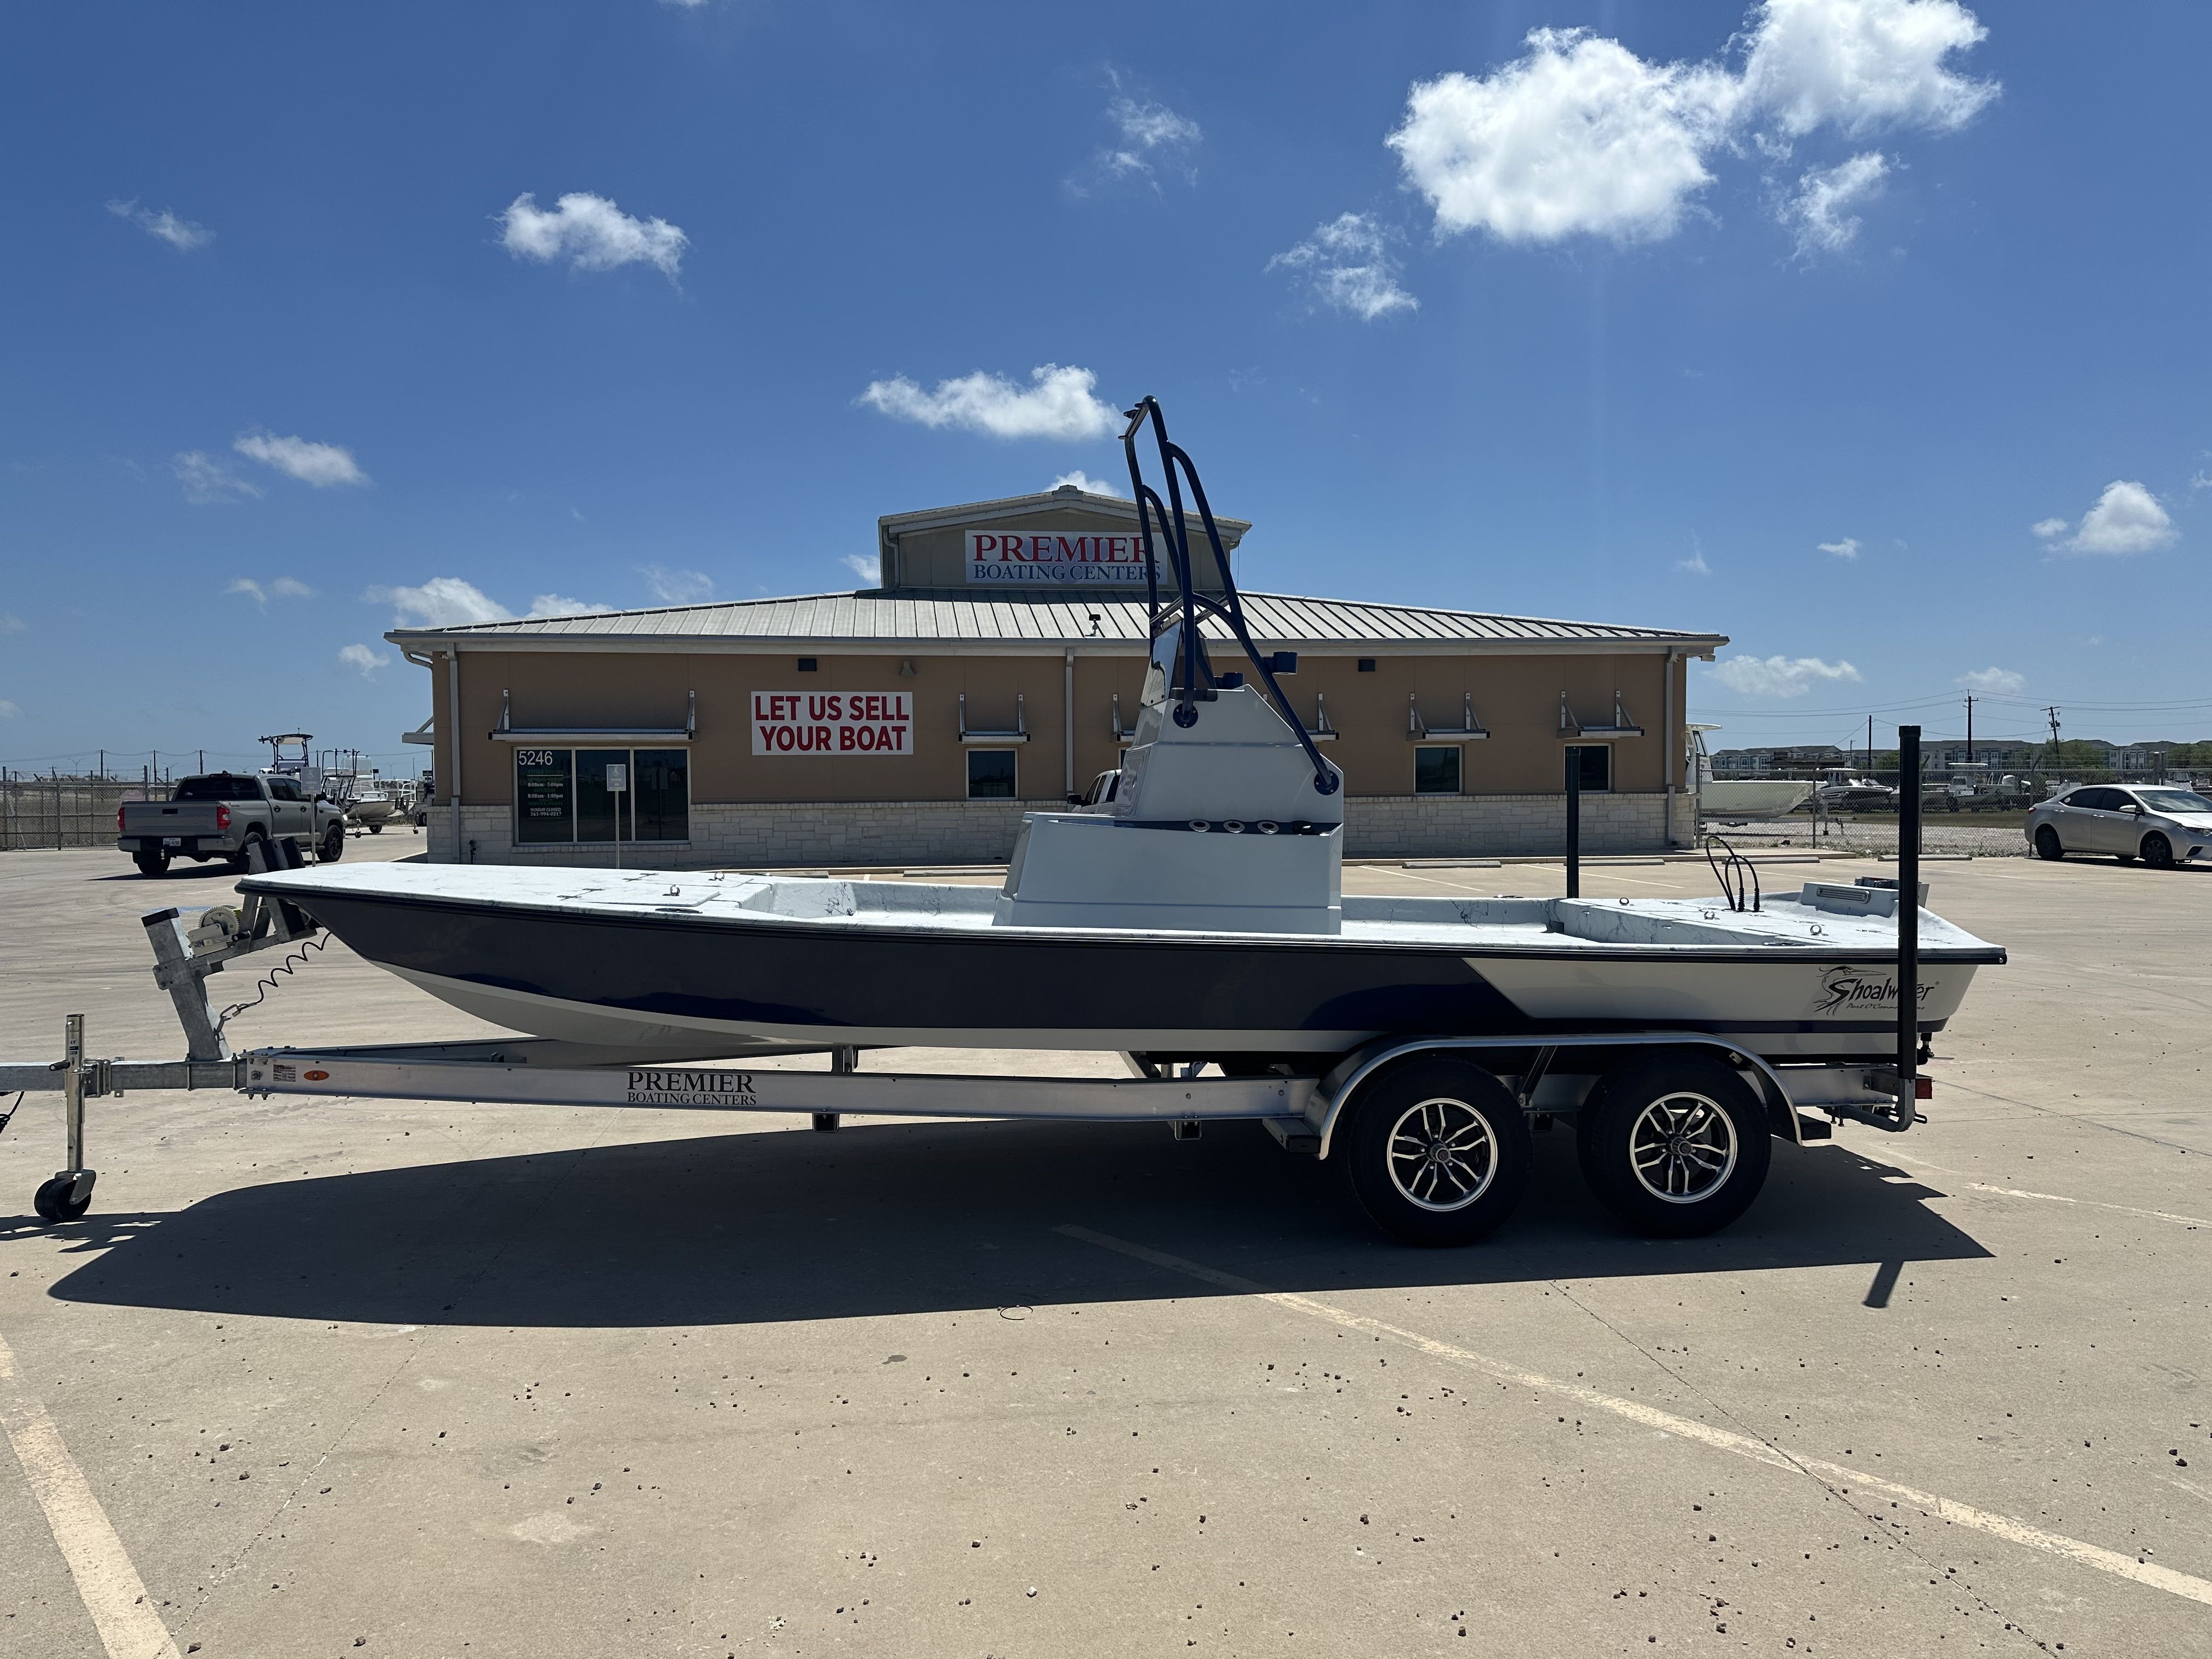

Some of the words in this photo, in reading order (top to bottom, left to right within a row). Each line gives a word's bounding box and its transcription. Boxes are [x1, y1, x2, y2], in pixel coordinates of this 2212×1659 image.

[973, 535, 1160, 563] PREMIER
[974, 564, 1065, 580] BOATING
[1070, 565, 1161, 580] CENTERS
[755, 696, 801, 721] LET
[809, 696, 842, 721] US
[849, 696, 909, 721] SELL
[759, 726, 832, 751] YOUR
[839, 725, 906, 751] BOAT
[518, 751, 553, 766] 5246
[1815, 977, 1935, 1012] Shoalwer
[627, 1072, 756, 1093] PREMIER
[628, 1092, 690, 1104] BOATING
[692, 1094, 757, 1105] CENTERS
